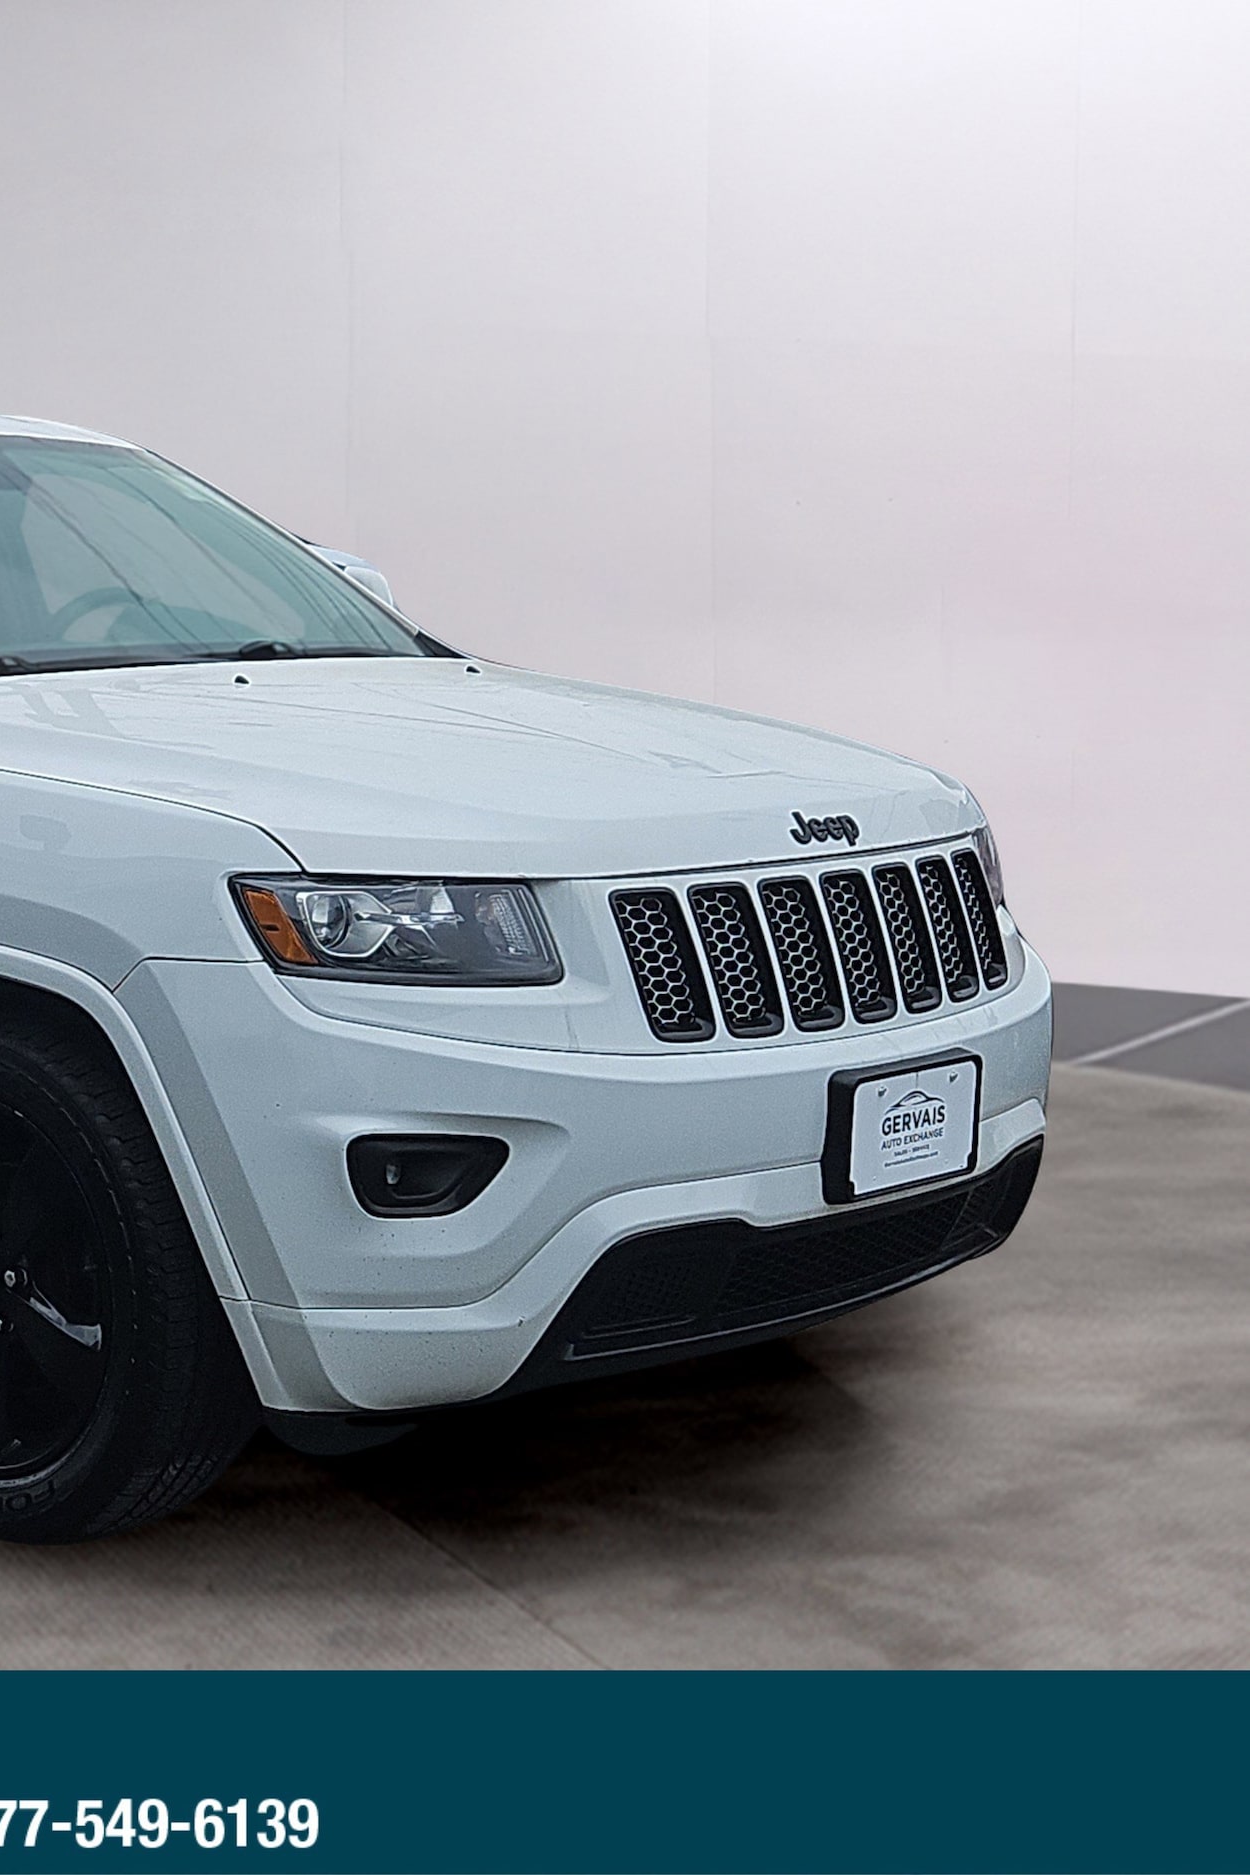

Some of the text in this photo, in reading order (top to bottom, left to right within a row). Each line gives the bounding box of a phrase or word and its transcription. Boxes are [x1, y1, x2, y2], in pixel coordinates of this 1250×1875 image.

[789, 811, 860, 847] Jeep
[881, 1105, 946, 1137] GERVAIS
[881, 1127, 945, 1151] AUTO EXCHANGE
